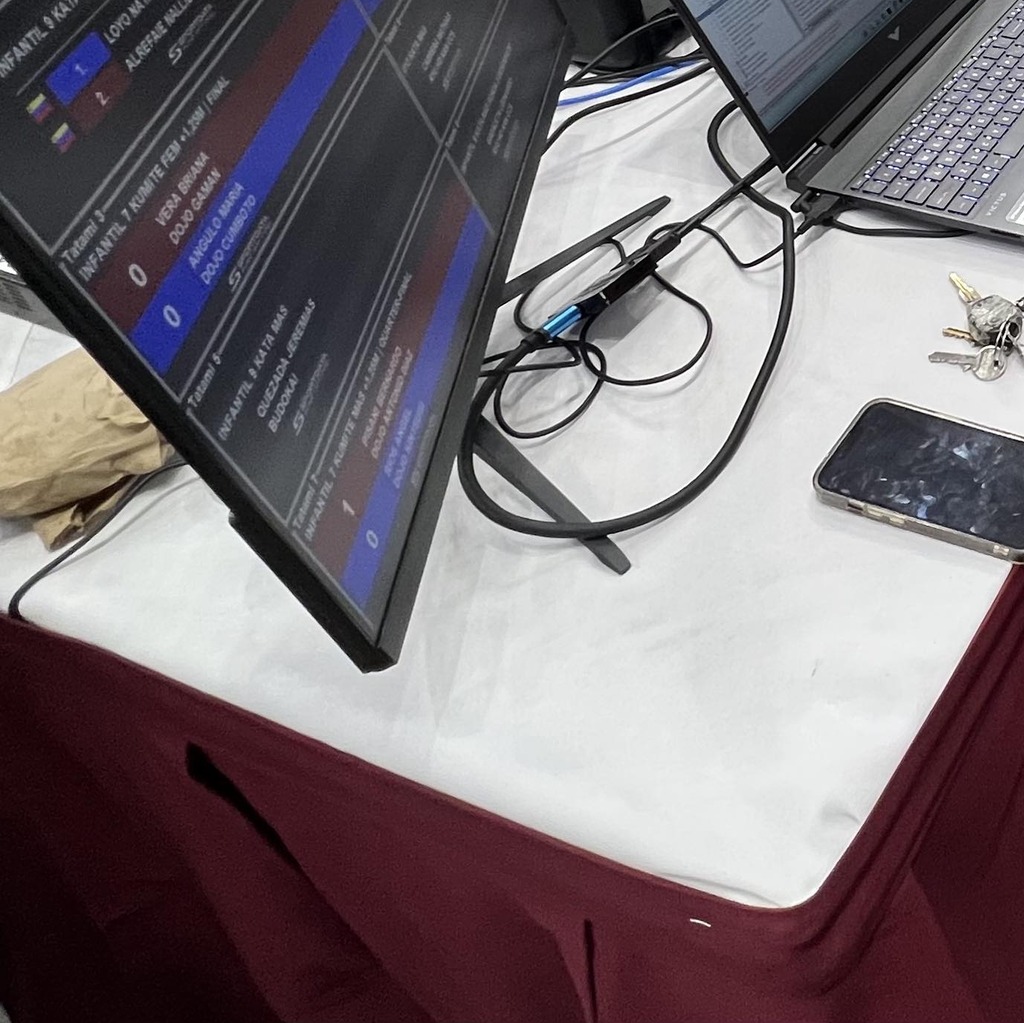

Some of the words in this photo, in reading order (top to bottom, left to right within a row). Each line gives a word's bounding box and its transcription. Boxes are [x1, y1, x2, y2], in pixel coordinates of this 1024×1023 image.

[104, 13, 131, 44] LOYO
[79, 222, 126, 280] INFANTIL
[120, 208, 131, 221] 7
[129, 164, 164, 211] KUMITE
[160, 140, 180, 167] FEM
[206, 76, 229, 104] FINAL
[169, 209, 194, 244] DOJO
[191, 168, 220, 210] GAMAN
[61, 219, 97, 262] Tatami
[94, 209, 105, 222] 3
[128, 263, 147, 287] 0
[155, 193, 181, 225] VERA
[178, 152, 208, 194] BRIANA
[163, 305, 180, 327] 0
[189, 217, 221, 268] ANGULO
[218, 182, 243, 217] MARIA
[200, 249, 224, 284] DOJO
[221, 194, 255, 249] CUMBOTO
[187, 363, 215, 406] Tatami
[218, 381, 252, 440] INFANTIL
[254, 333, 274, 369] KATA
[271, 305, 287, 333] MAS
[257, 358, 289, 417] QUEZADA
[366, 529, 378, 549] 0
